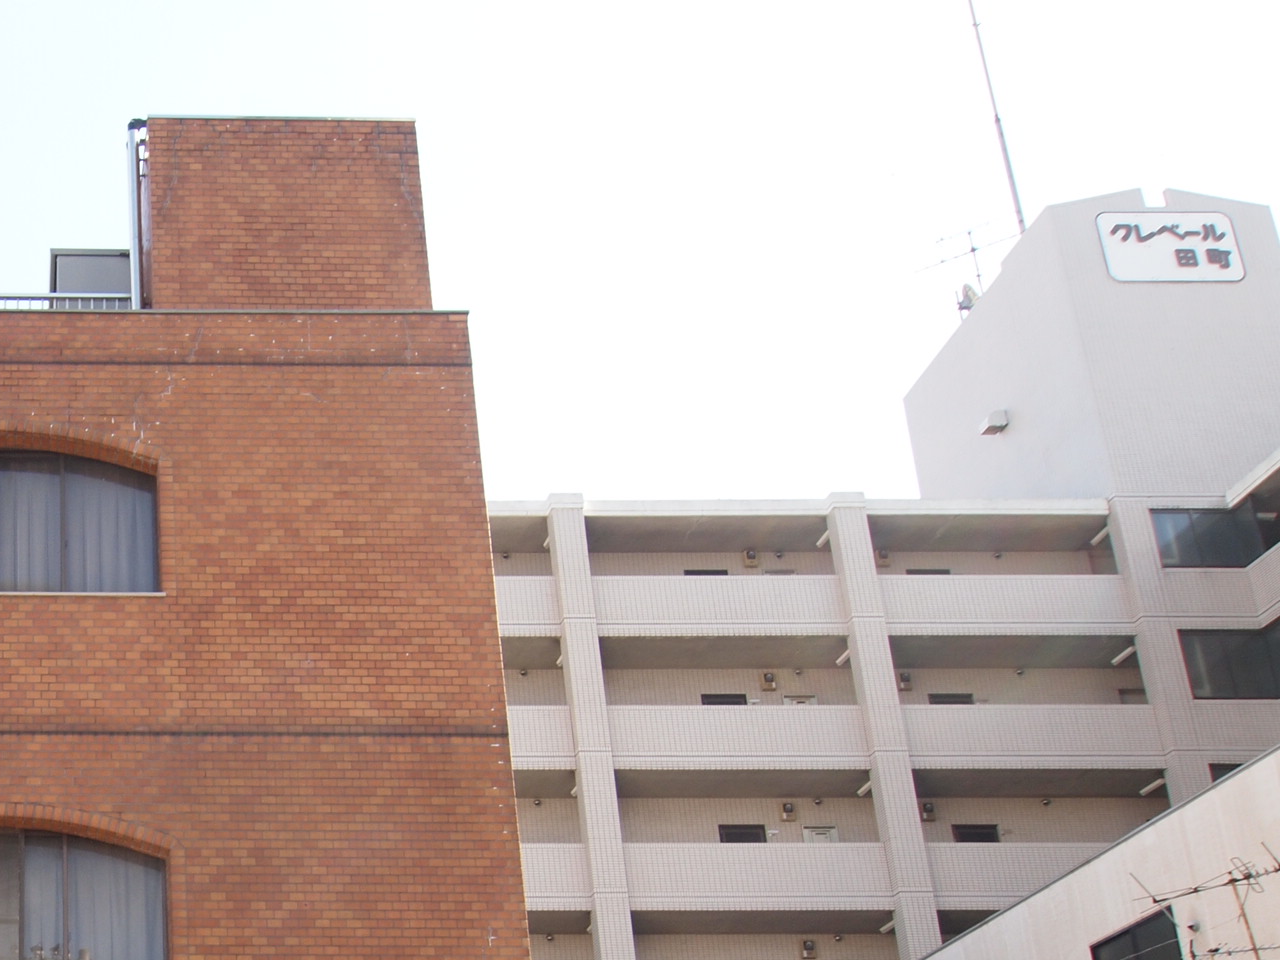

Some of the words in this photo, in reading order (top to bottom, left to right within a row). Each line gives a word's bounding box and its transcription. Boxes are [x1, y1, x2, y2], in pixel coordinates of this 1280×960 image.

[1109, 223, 1226, 243] クレベール
[1175, 248, 1231, 269] 田町
